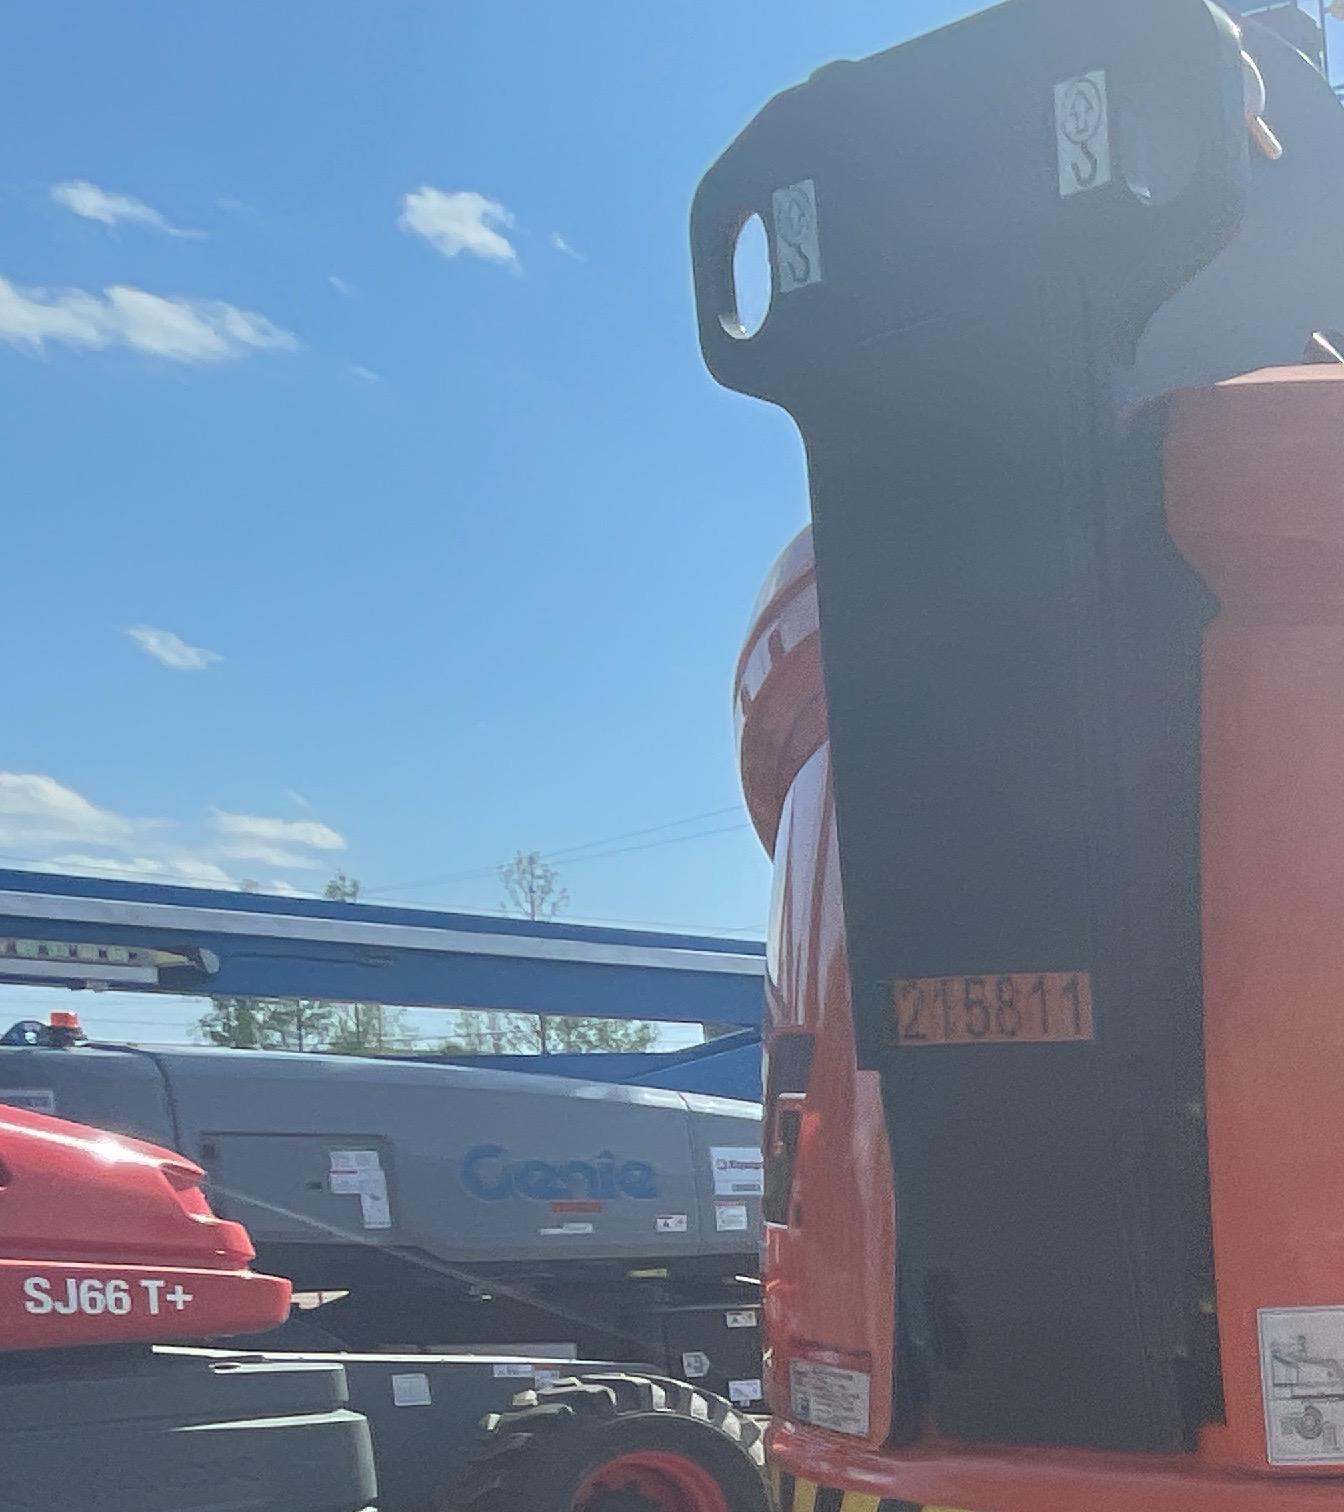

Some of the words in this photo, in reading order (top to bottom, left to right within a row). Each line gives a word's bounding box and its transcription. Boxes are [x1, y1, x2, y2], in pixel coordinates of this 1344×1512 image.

[461, 1144, 657, 1201] Genie
[23, 1276, 132, 1315] SJ66
[139, 1279, 194, 1315] T+
